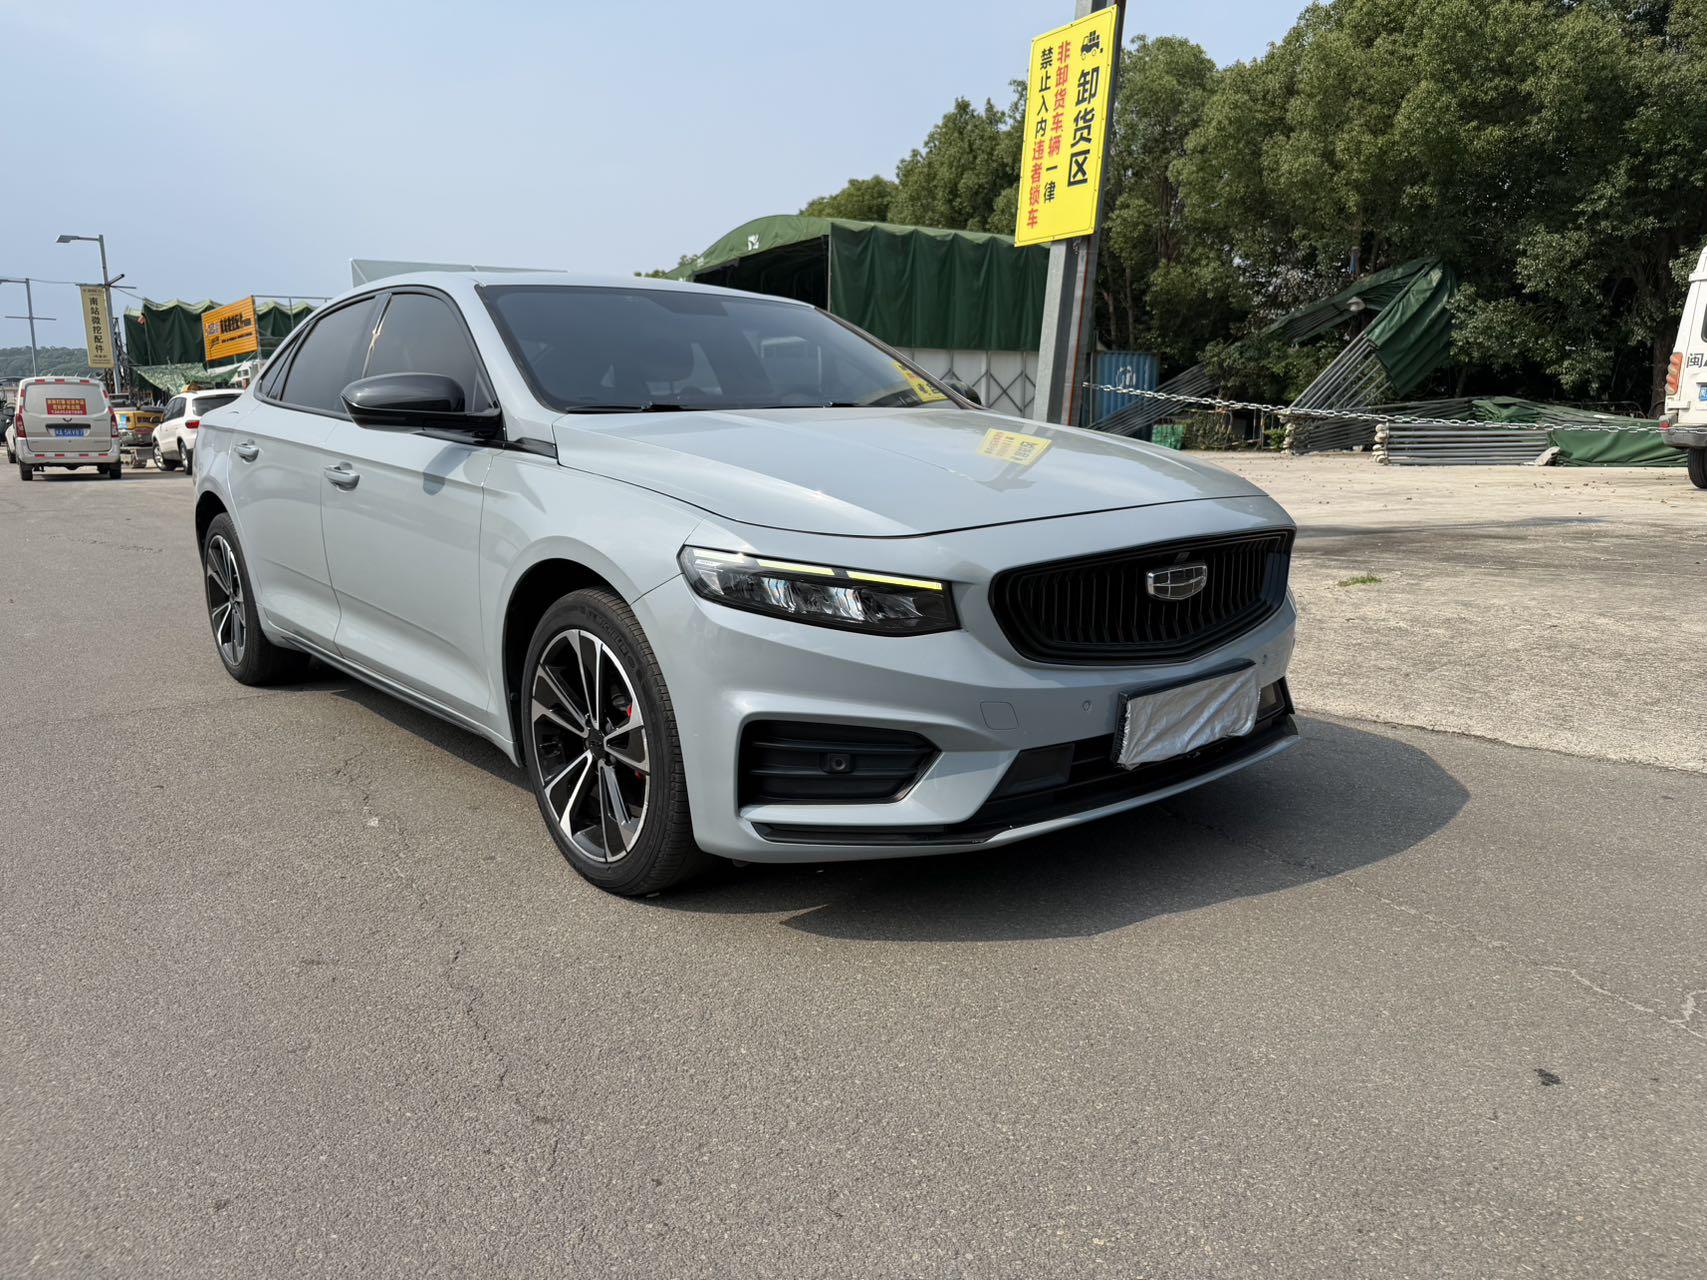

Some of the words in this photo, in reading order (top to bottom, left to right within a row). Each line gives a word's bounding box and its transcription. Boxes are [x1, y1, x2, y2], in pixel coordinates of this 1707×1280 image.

[1026, 47, 1053, 229] 禁止入内违者锁车
[1043, 40, 1072, 204] 非卸货车辆一律
[1067, 66, 1100, 187] 卸货区
[89, 296, 104, 353] 南站微挖配件
[1686, 353, 1707, 368] 闽
